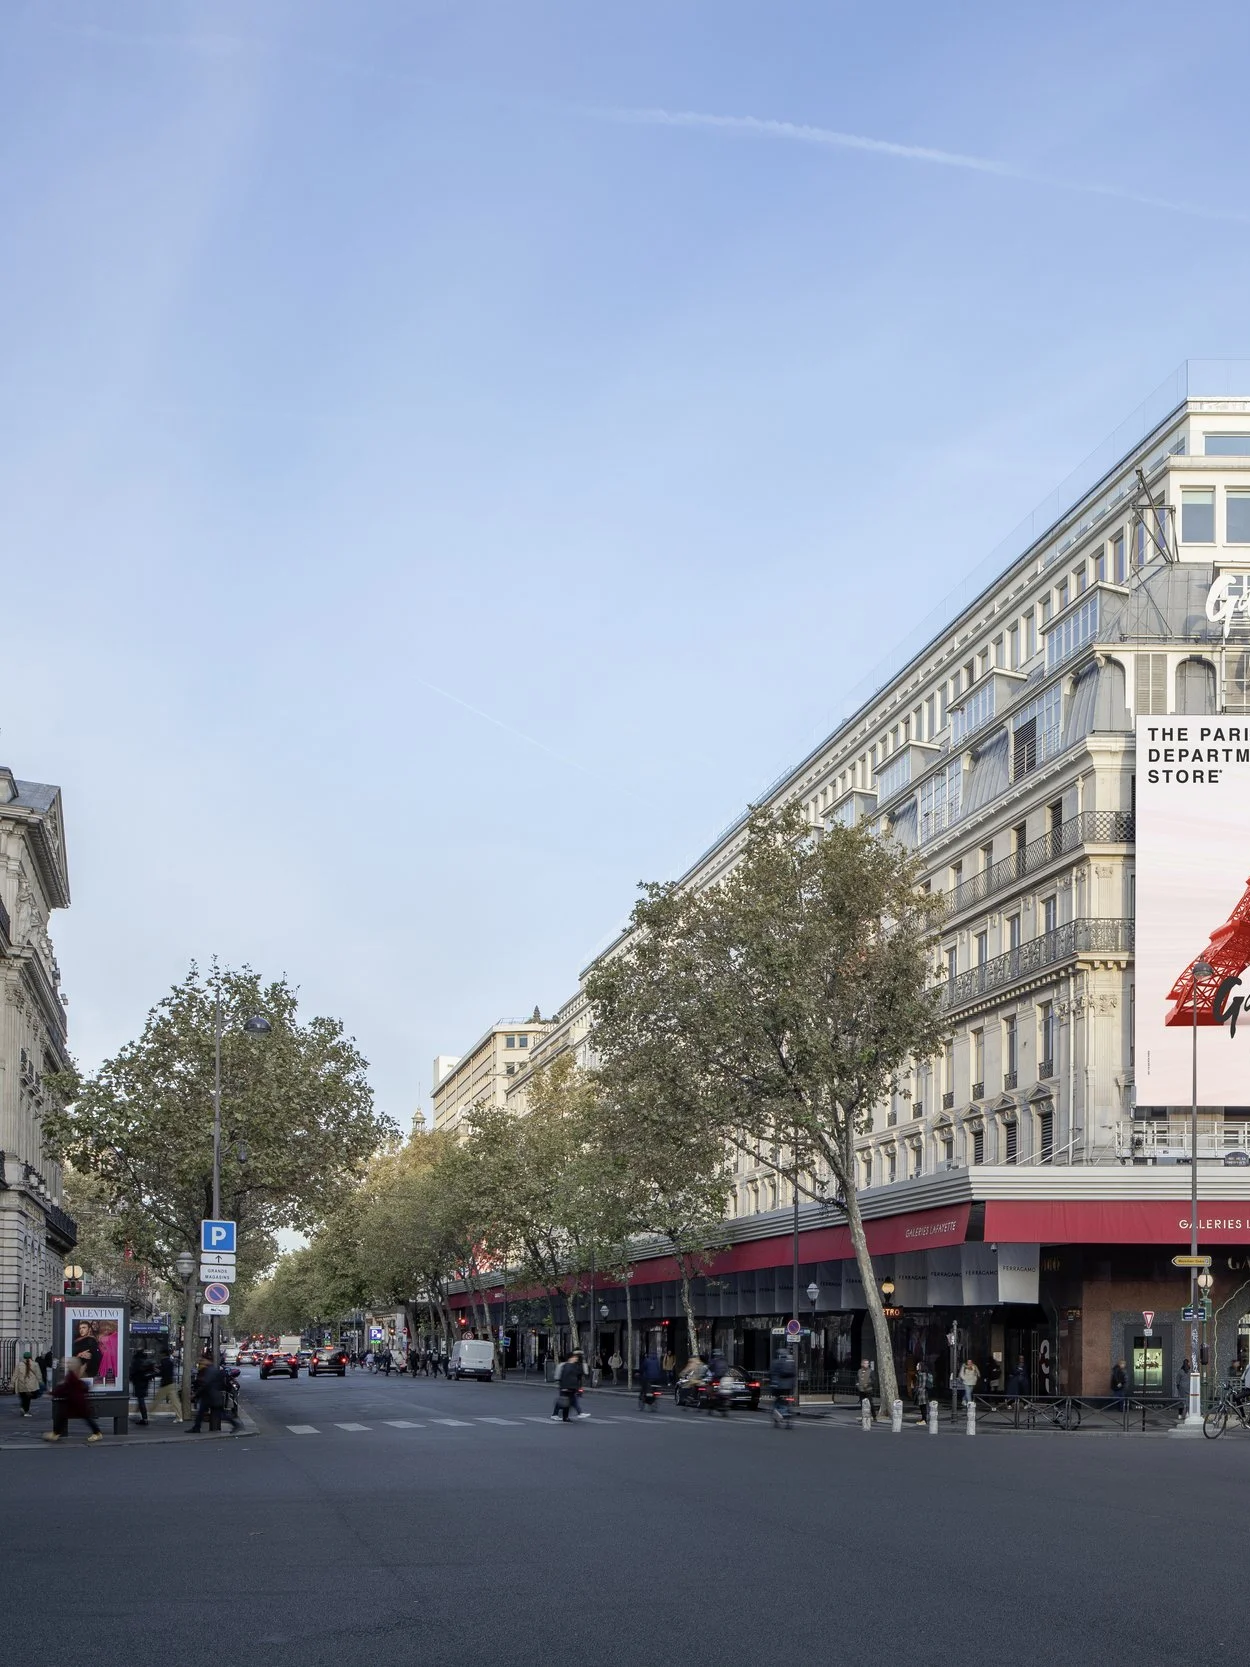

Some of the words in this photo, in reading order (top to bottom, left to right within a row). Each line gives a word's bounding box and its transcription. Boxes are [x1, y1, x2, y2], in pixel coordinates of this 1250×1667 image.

[1147, 727, 1188, 742] THE
[905, 1225, 929, 1237] GALERIES
[929, 1220, 957, 1235] LAFAYETTE
[211, 1226, 226, 1246] P
[1002, 1265, 1036, 1273] FERRAGAMO
[72, 1309, 118, 1318] VALENTINO
[882, 1308, 900, 1316] ETRO
